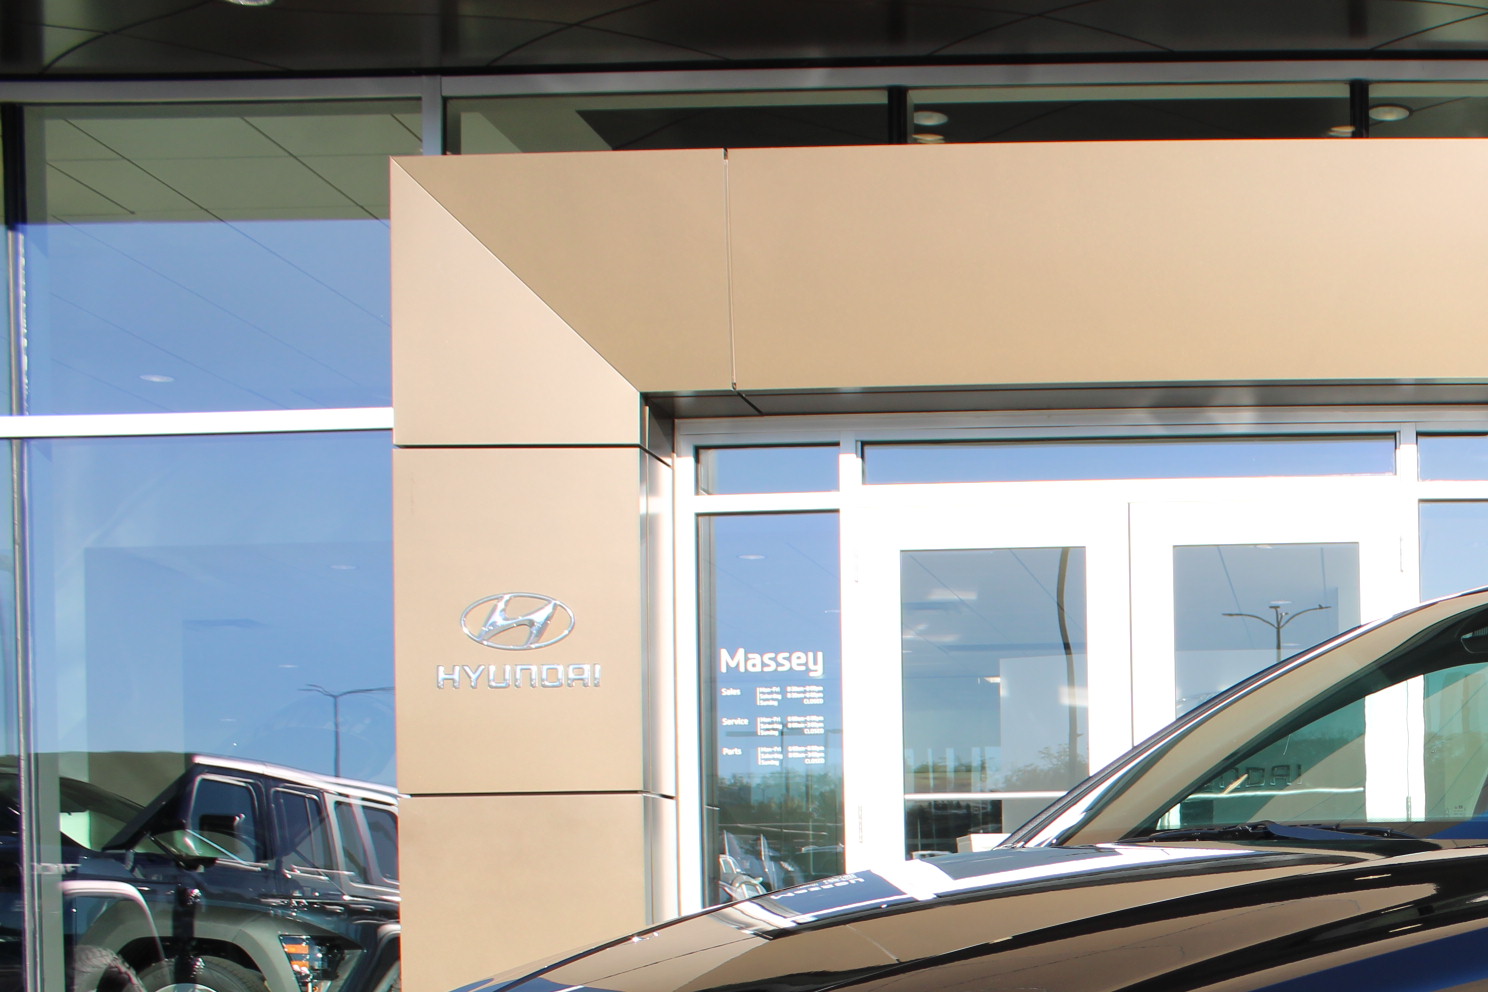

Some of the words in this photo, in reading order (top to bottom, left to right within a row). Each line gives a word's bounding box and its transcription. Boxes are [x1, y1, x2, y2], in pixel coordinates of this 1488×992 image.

[720, 647, 824, 677] Massey
[436, 664, 602, 689] HYUNDAI
[721, 688, 741, 696] Sales
[722, 717, 749, 725] Service
[722, 747, 742, 755] Parts
